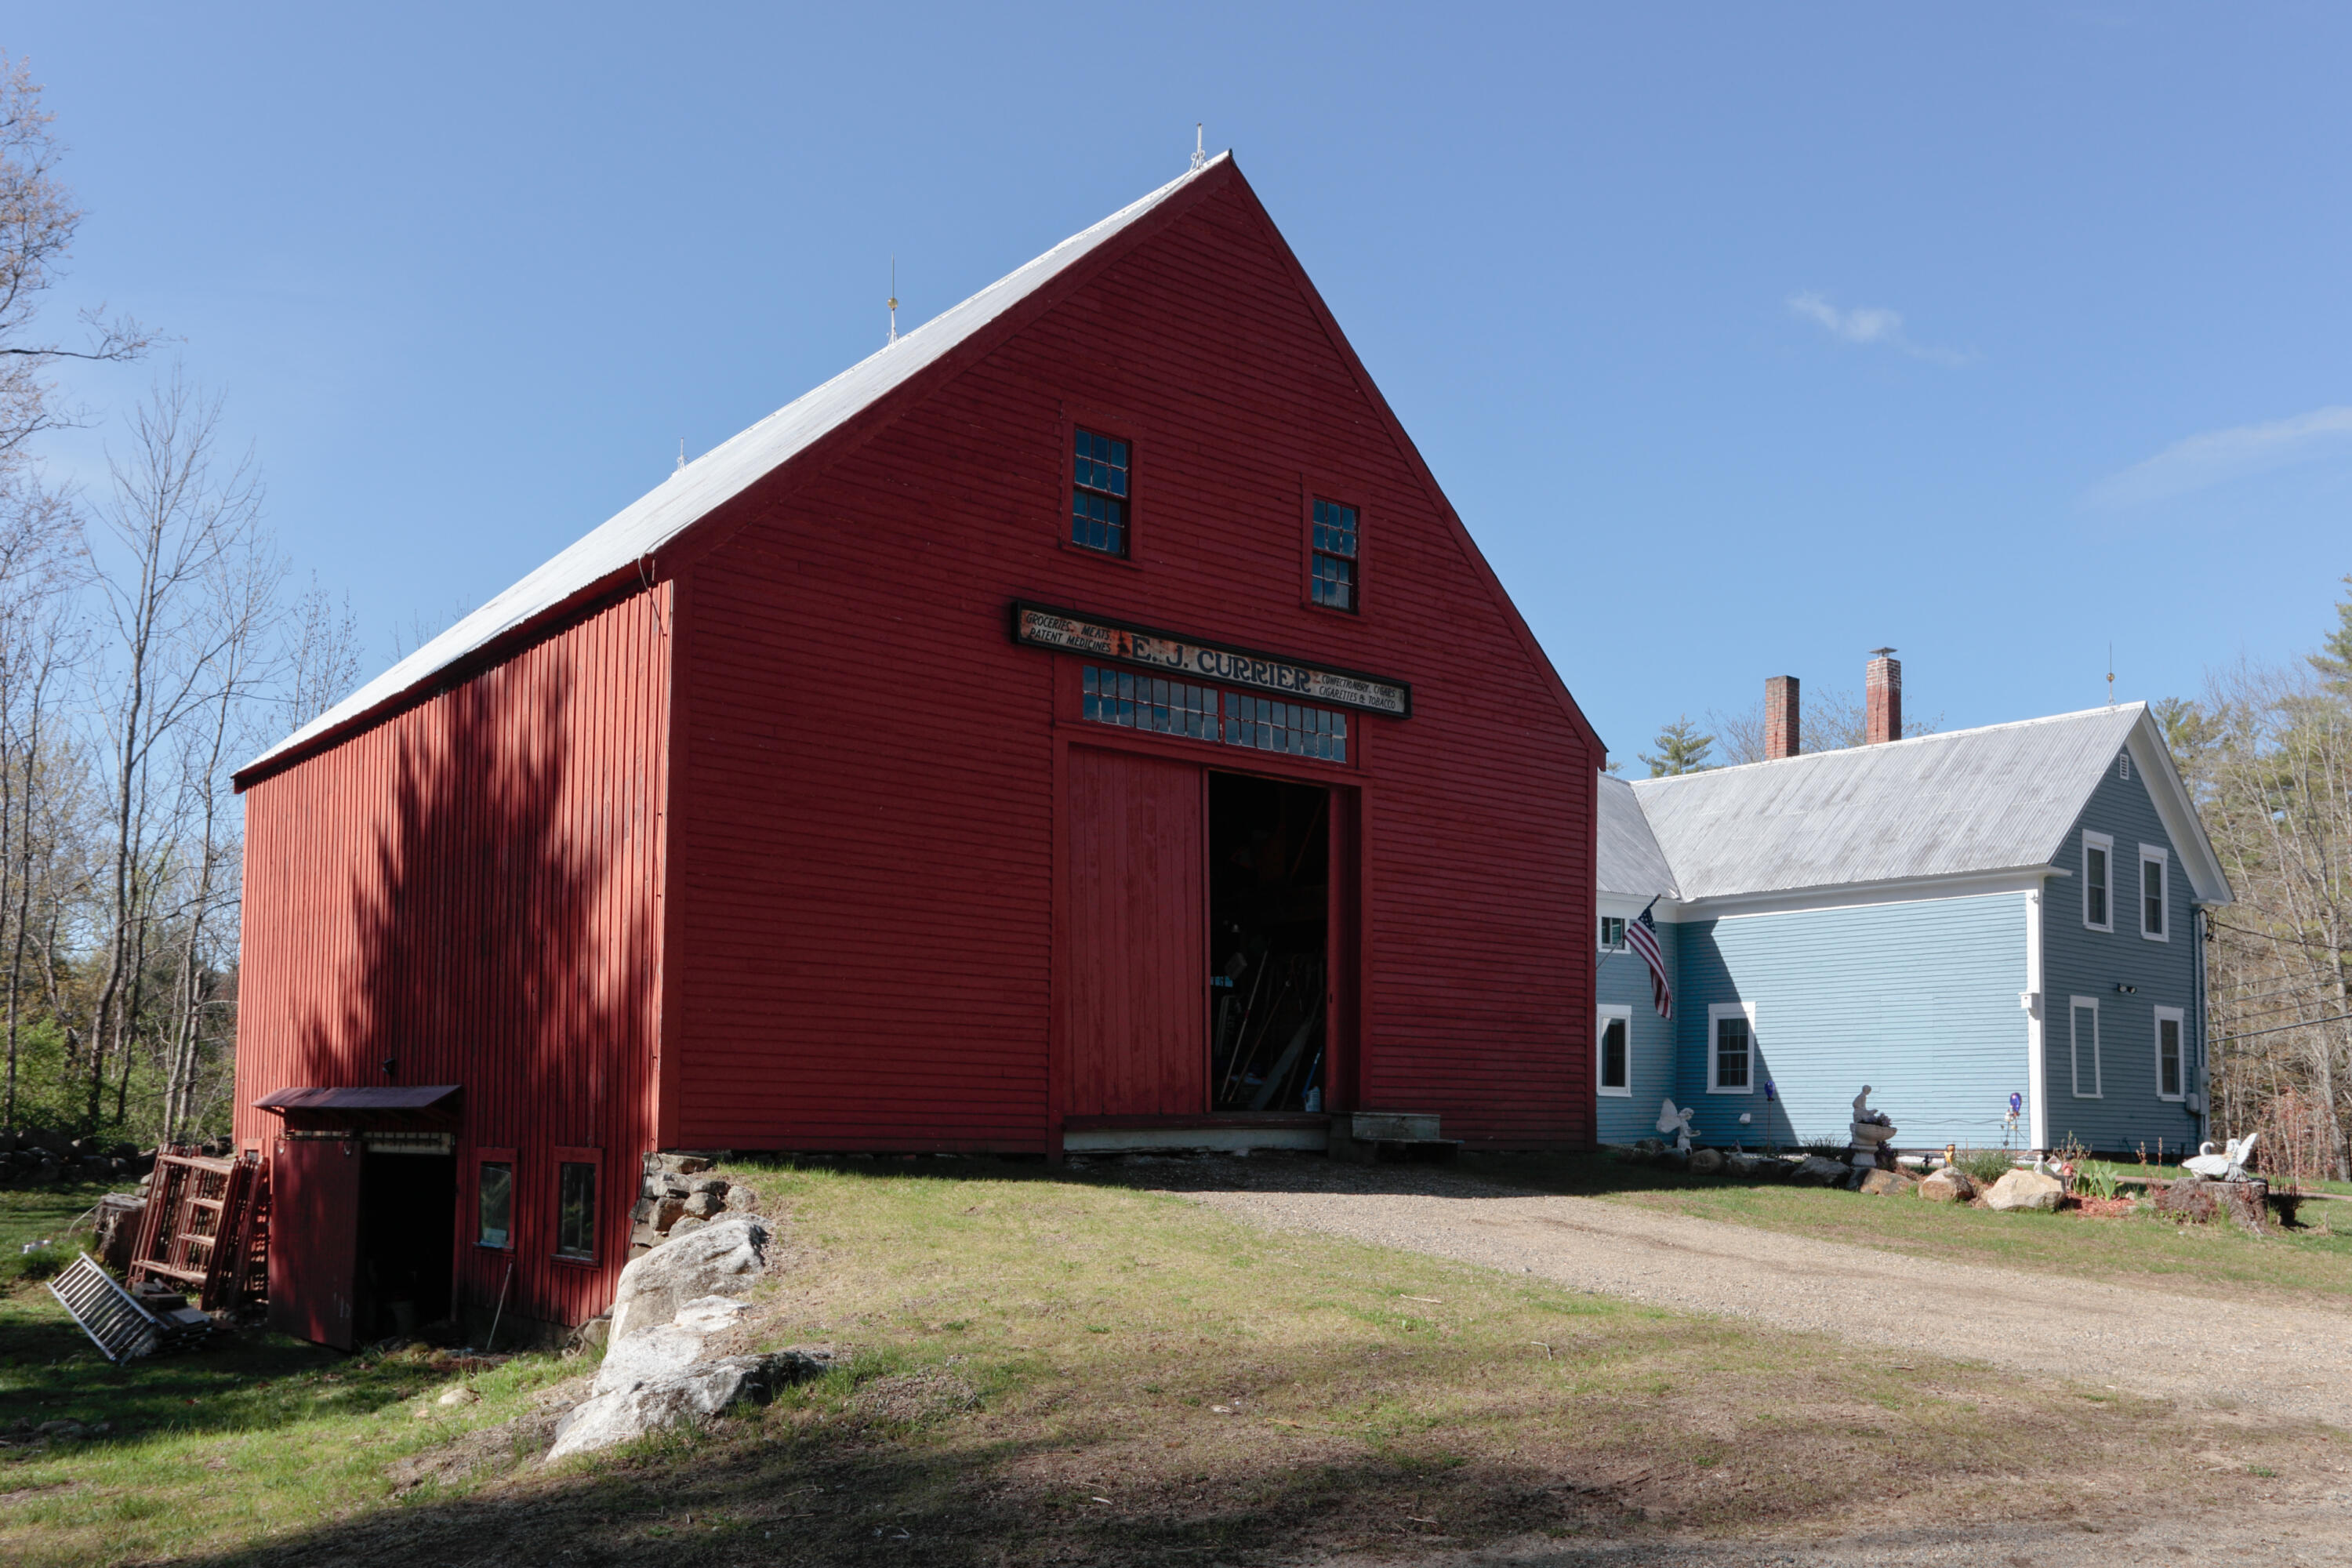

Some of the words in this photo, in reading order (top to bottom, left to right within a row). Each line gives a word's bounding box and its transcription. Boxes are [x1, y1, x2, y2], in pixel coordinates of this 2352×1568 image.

[1029, 627, 1063, 644] PATENT
[1066, 636, 1112, 653] MEDICINES
[1131, 635, 1157, 662] E.
[1167, 644, 1189, 668] J.
[1197, 650, 1312, 693] CURRIER
[1319, 686, 1357, 702] CIGARETTES
[1359, 695, 1366, 704] &
[1368, 695, 1396, 710] TOBACCO
[1374, 685, 1396, 698] CIGARS
